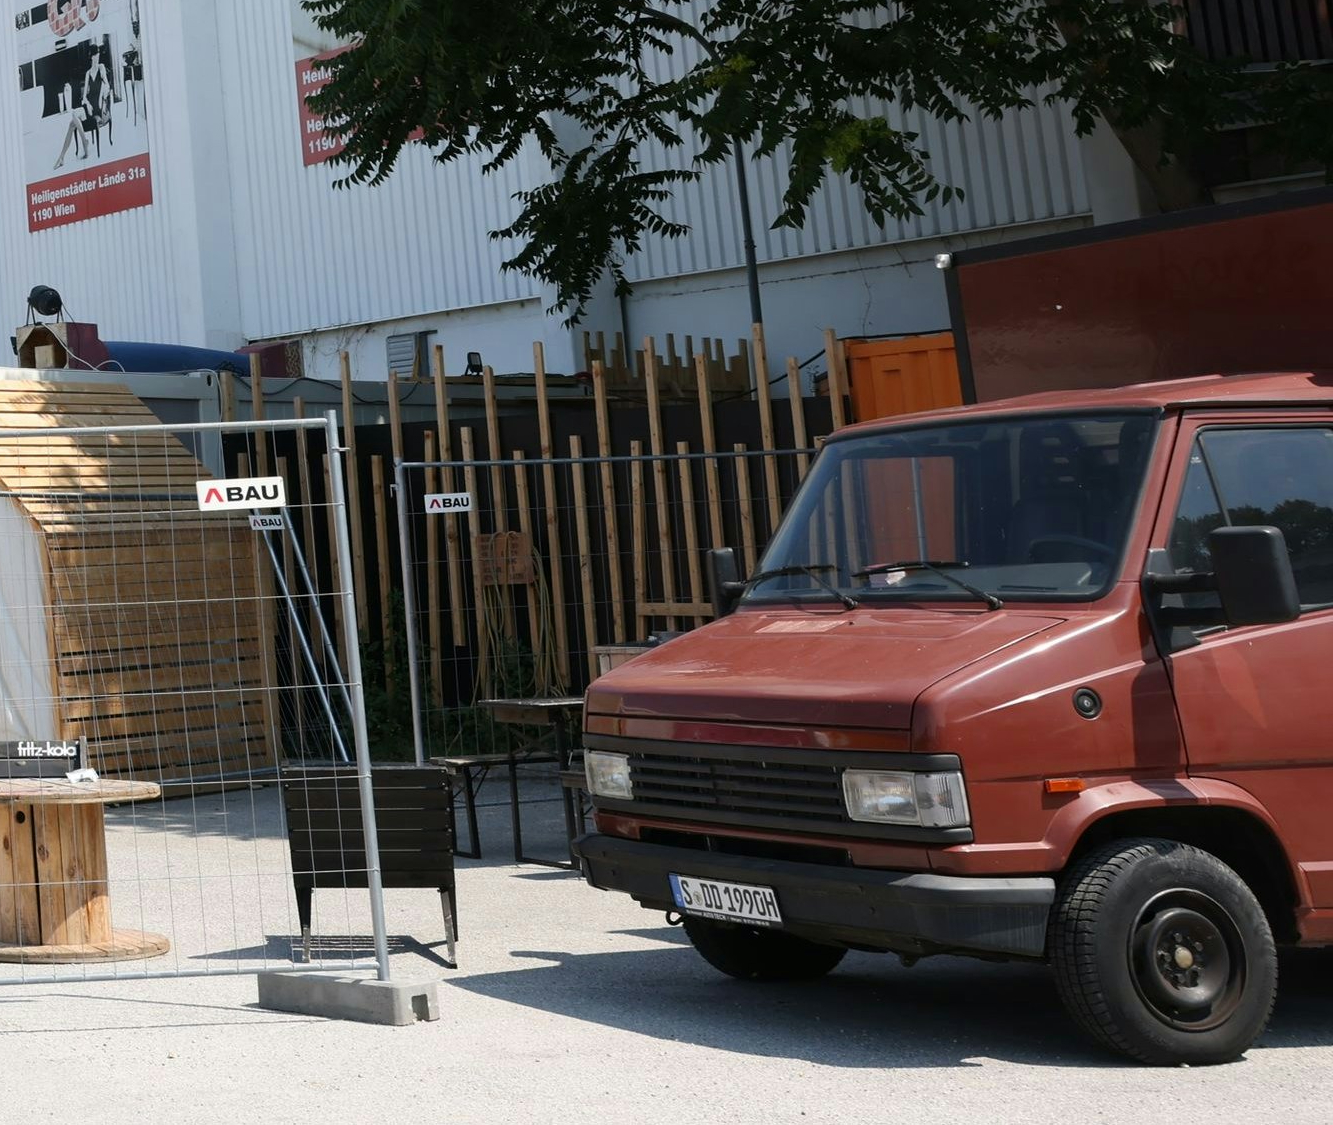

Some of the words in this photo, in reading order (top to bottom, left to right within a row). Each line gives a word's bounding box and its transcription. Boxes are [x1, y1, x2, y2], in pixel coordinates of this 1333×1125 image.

[31, 179, 97, 205] Heiligenstädter
[98, 171, 126, 188] Lände
[128, 167, 146, 181] 31a
[32, 207, 52, 222] 1190
[54, 203, 76, 217] Wien
[681, 880, 693, 905] S
[699, 882, 723, 910] DD
